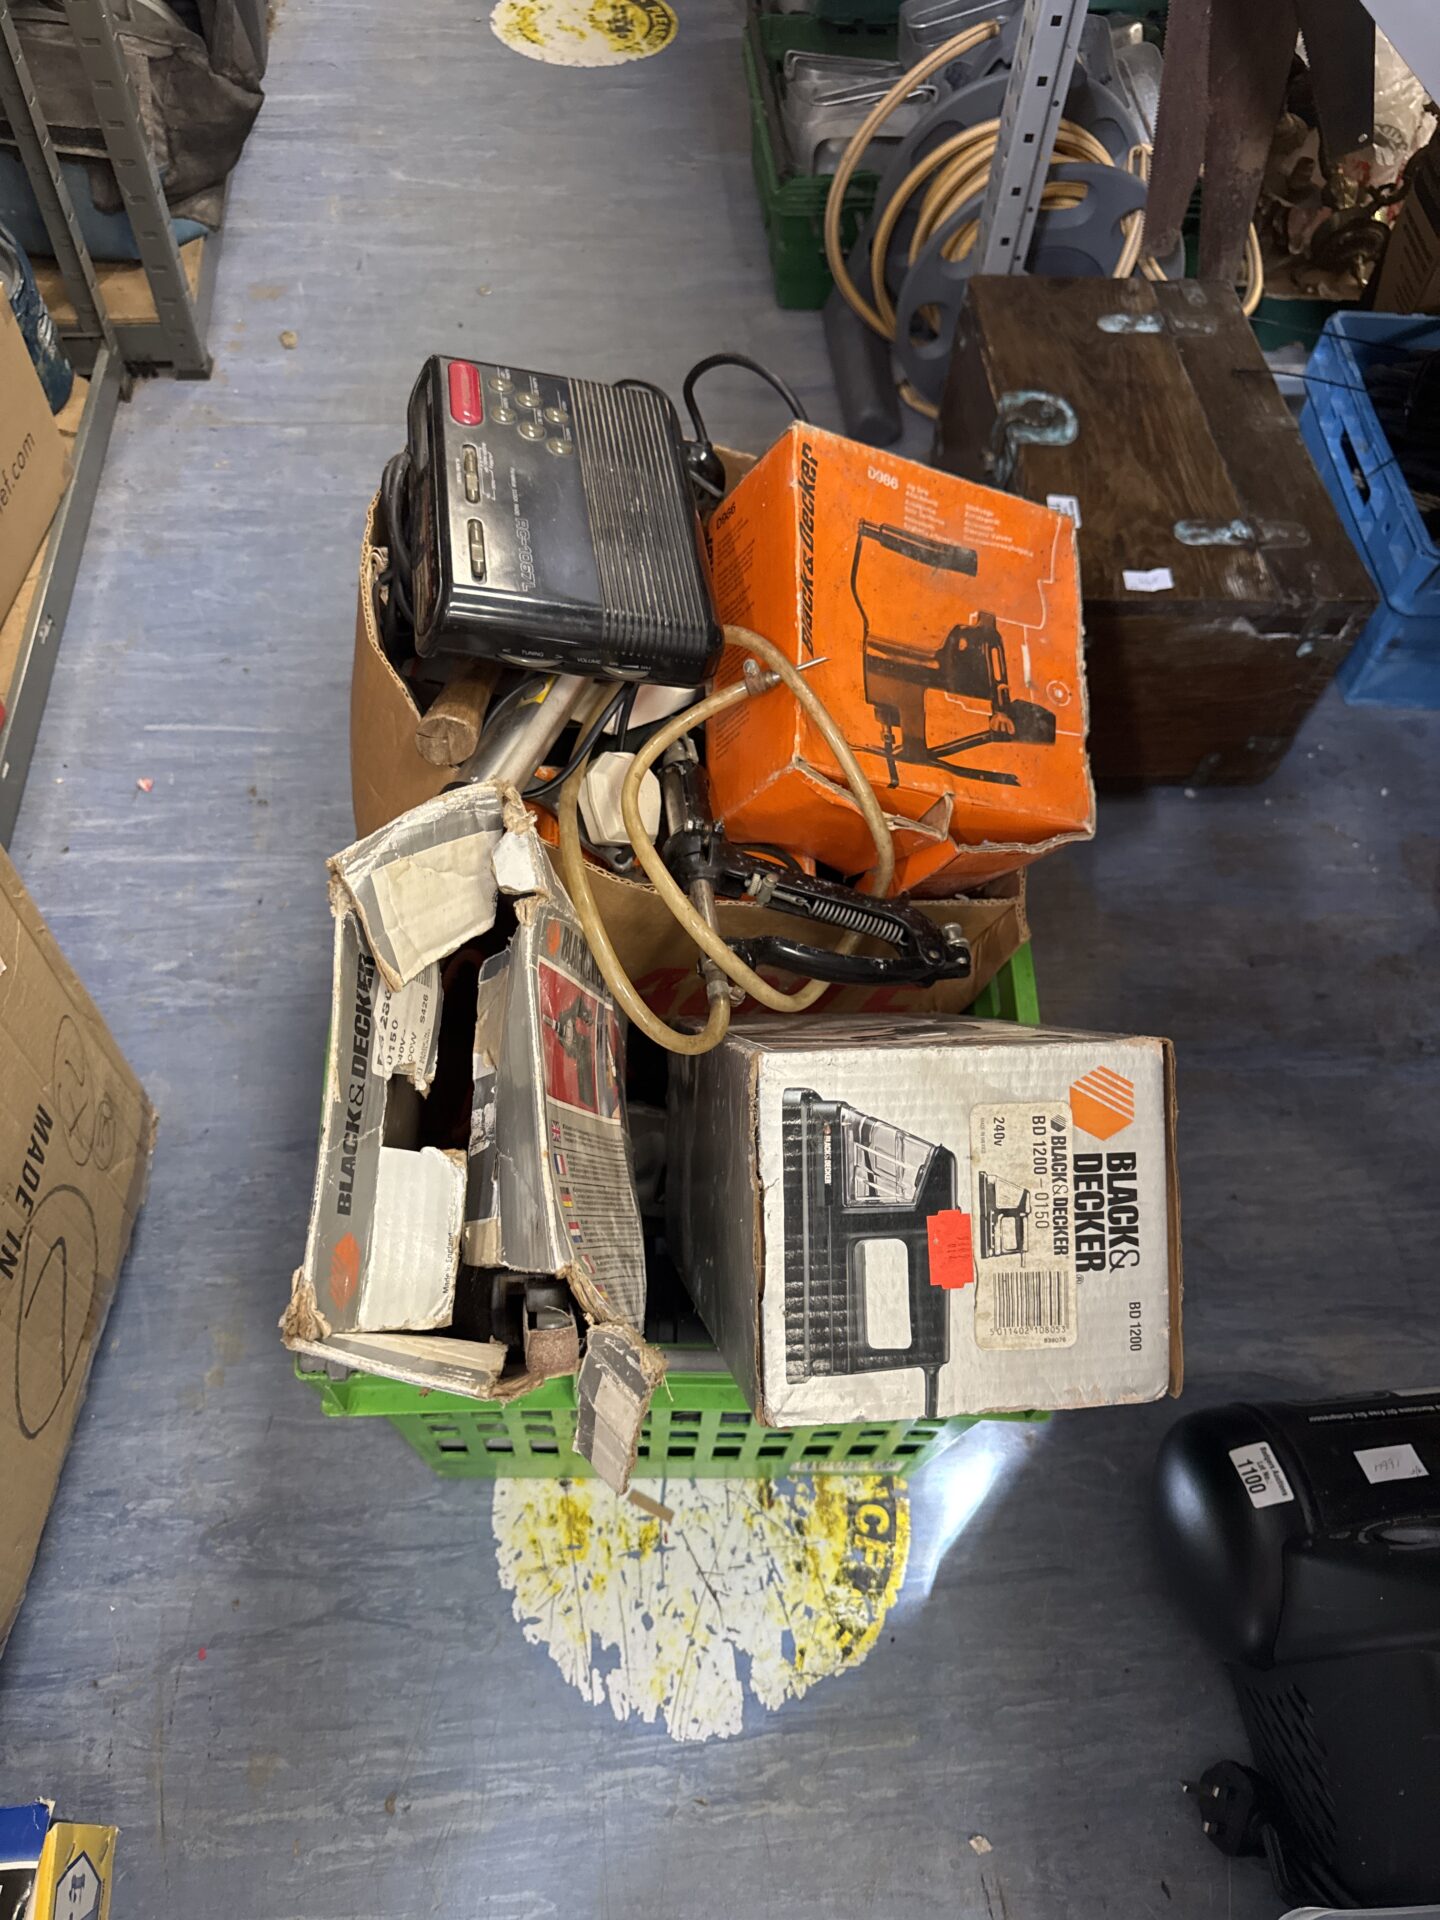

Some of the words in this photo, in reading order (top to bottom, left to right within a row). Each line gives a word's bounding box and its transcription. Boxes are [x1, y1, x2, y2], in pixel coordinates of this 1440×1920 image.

[0, 432, 35, 514] ef.com
[521, 649, 544, 657] TUNING
[576, 657, 601, 665] VOLUME
[408, 1031, 417, 1062] 00W
[993, 1116, 1006, 1147] 240v
[1032, 1115, 1046, 1136] BD
[15, 1103, 54, 1217] MADE
[1033, 1140, 1048, 1175] 1200
[1035, 1192, 1050, 1230] 0150
[442, 1272, 450, 1294] Made
[1129, 1301, 1141, 1318] BD
[1130, 1322, 1142, 1352] 1200
[1237, 1458, 1267, 1494] 1100
[1257, 1461, 1265, 1471] Lot
[1272, 1467, 1288, 1496] Auctions
